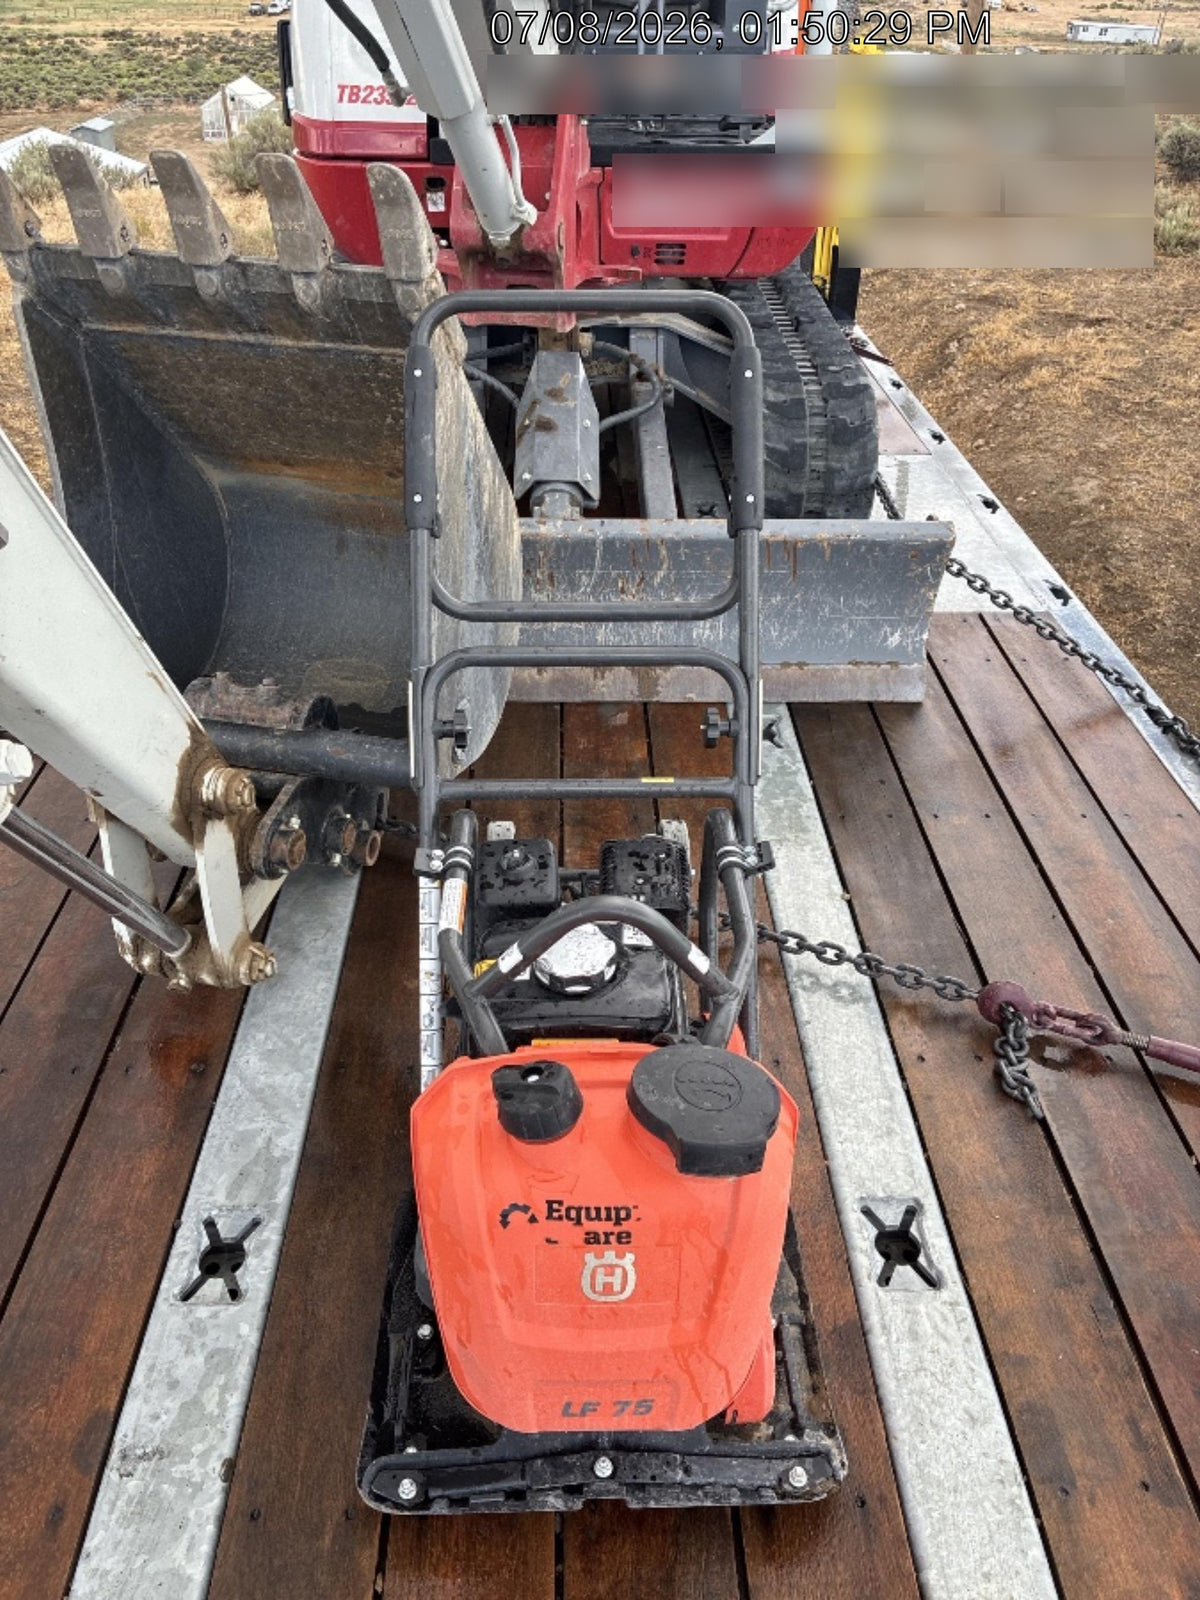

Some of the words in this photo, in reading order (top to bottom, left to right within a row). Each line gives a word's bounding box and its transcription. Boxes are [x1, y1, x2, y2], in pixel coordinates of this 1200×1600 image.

[545, 1199, 641, 1226] Equip
[562, 1401, 600, 1417] LF
[612, 1398, 655, 1417] 75
